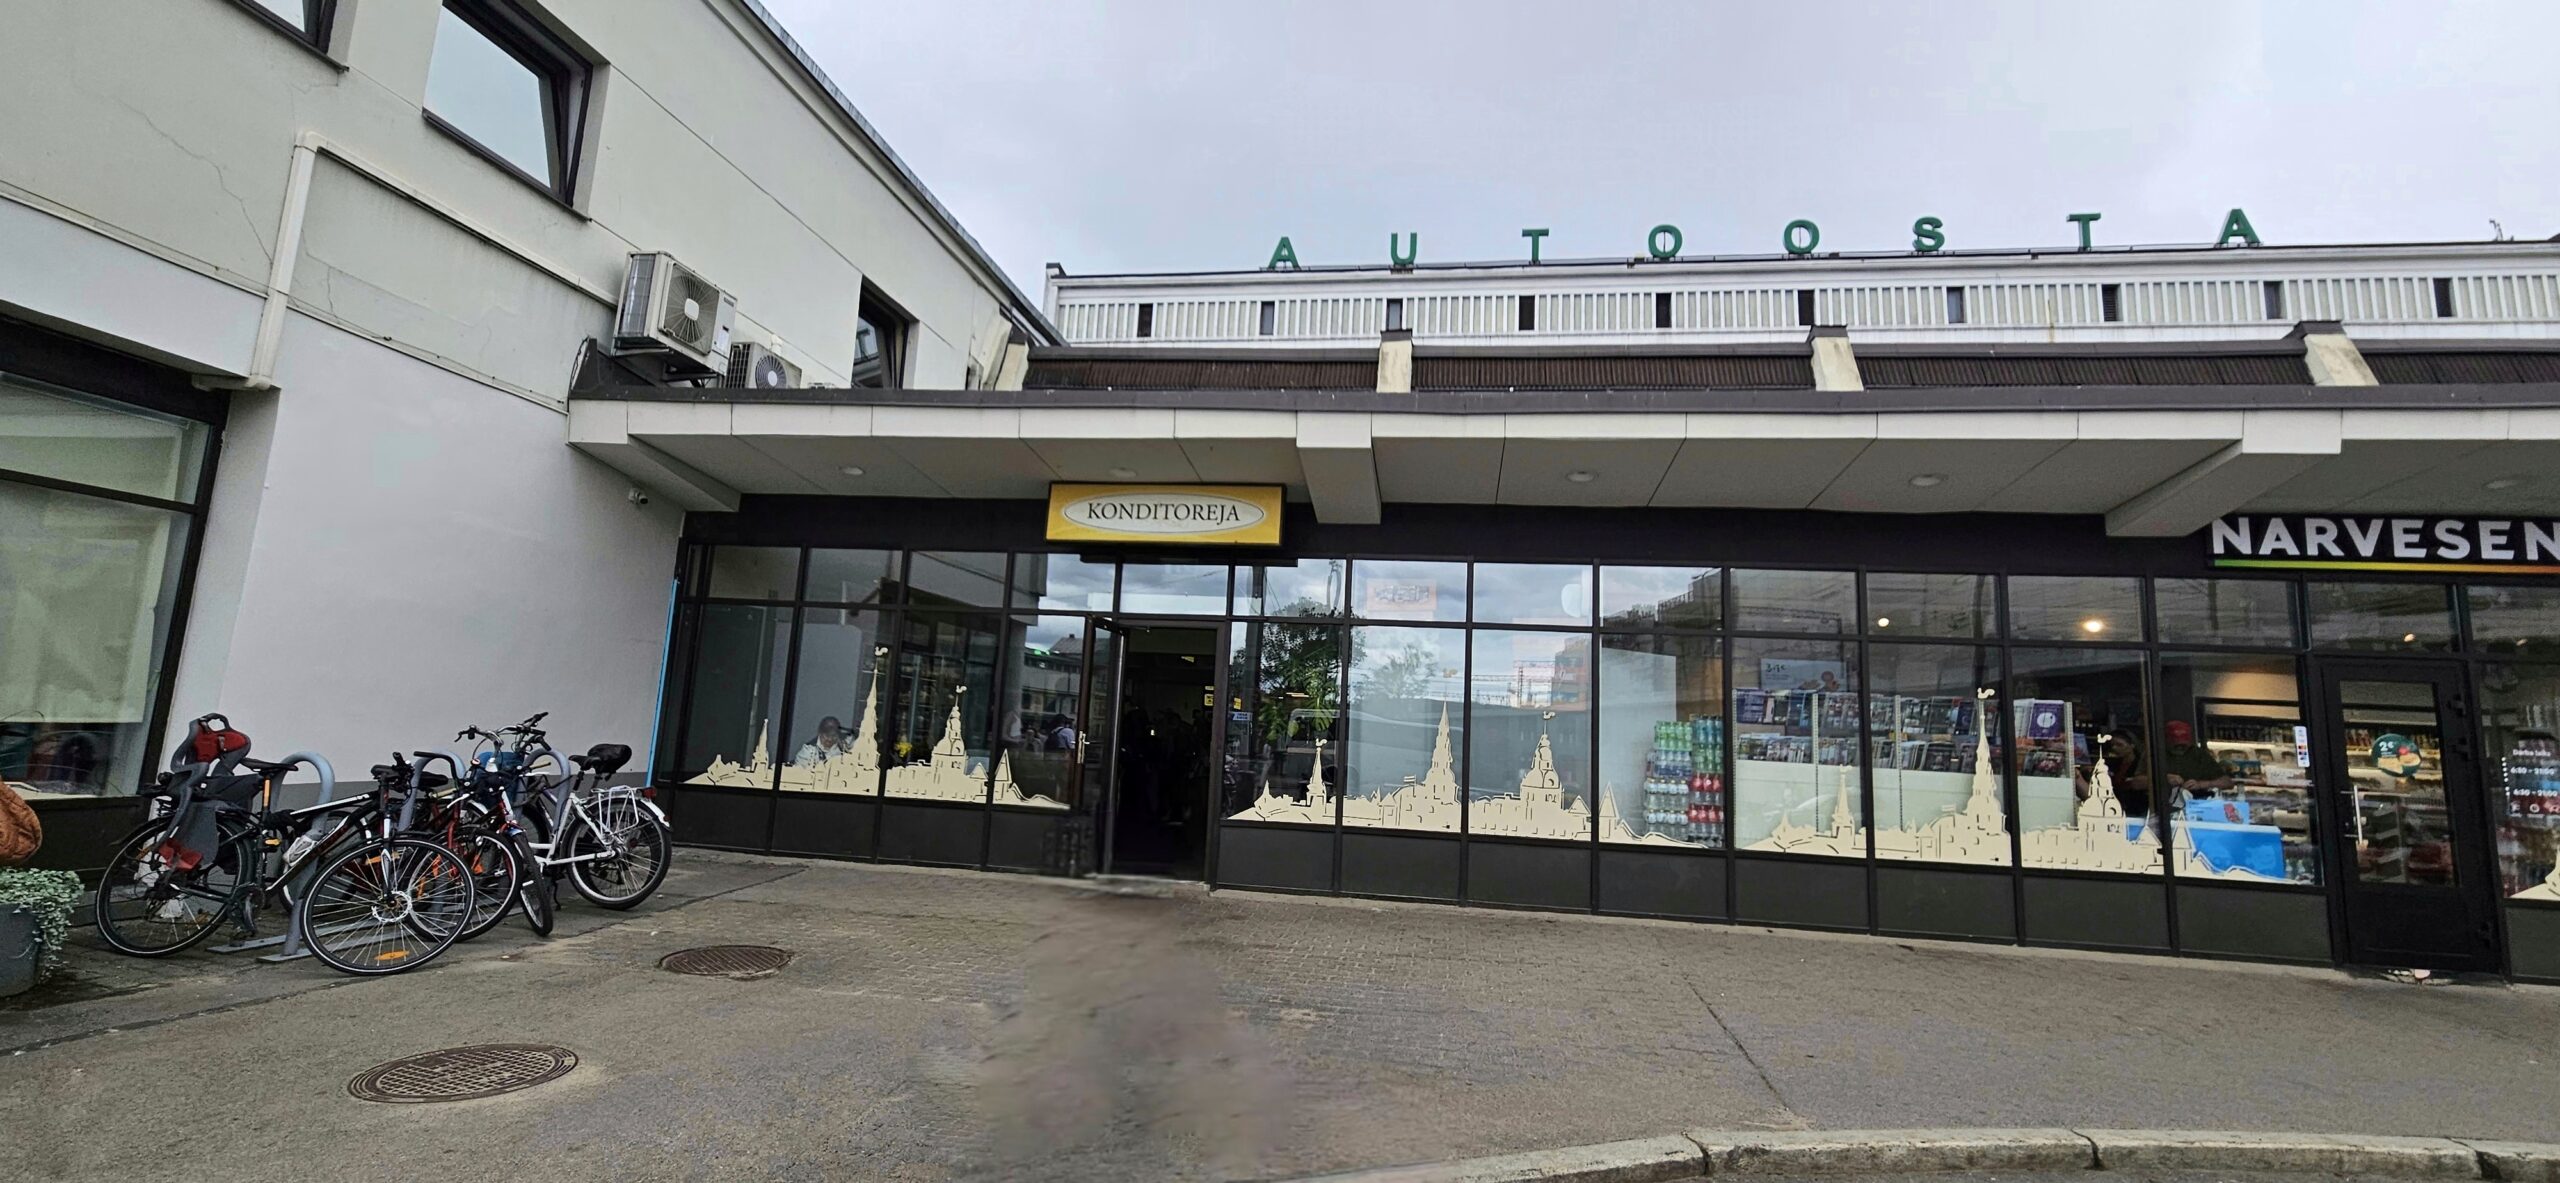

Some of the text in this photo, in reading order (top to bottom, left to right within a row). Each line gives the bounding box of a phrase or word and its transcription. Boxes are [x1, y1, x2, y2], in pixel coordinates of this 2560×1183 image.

[1268, 209, 2260, 267] AUTOOSTA
[1087, 502, 1241, 526] KONDITOREJA
[2211, 516, 2560, 561] NARVESEN
